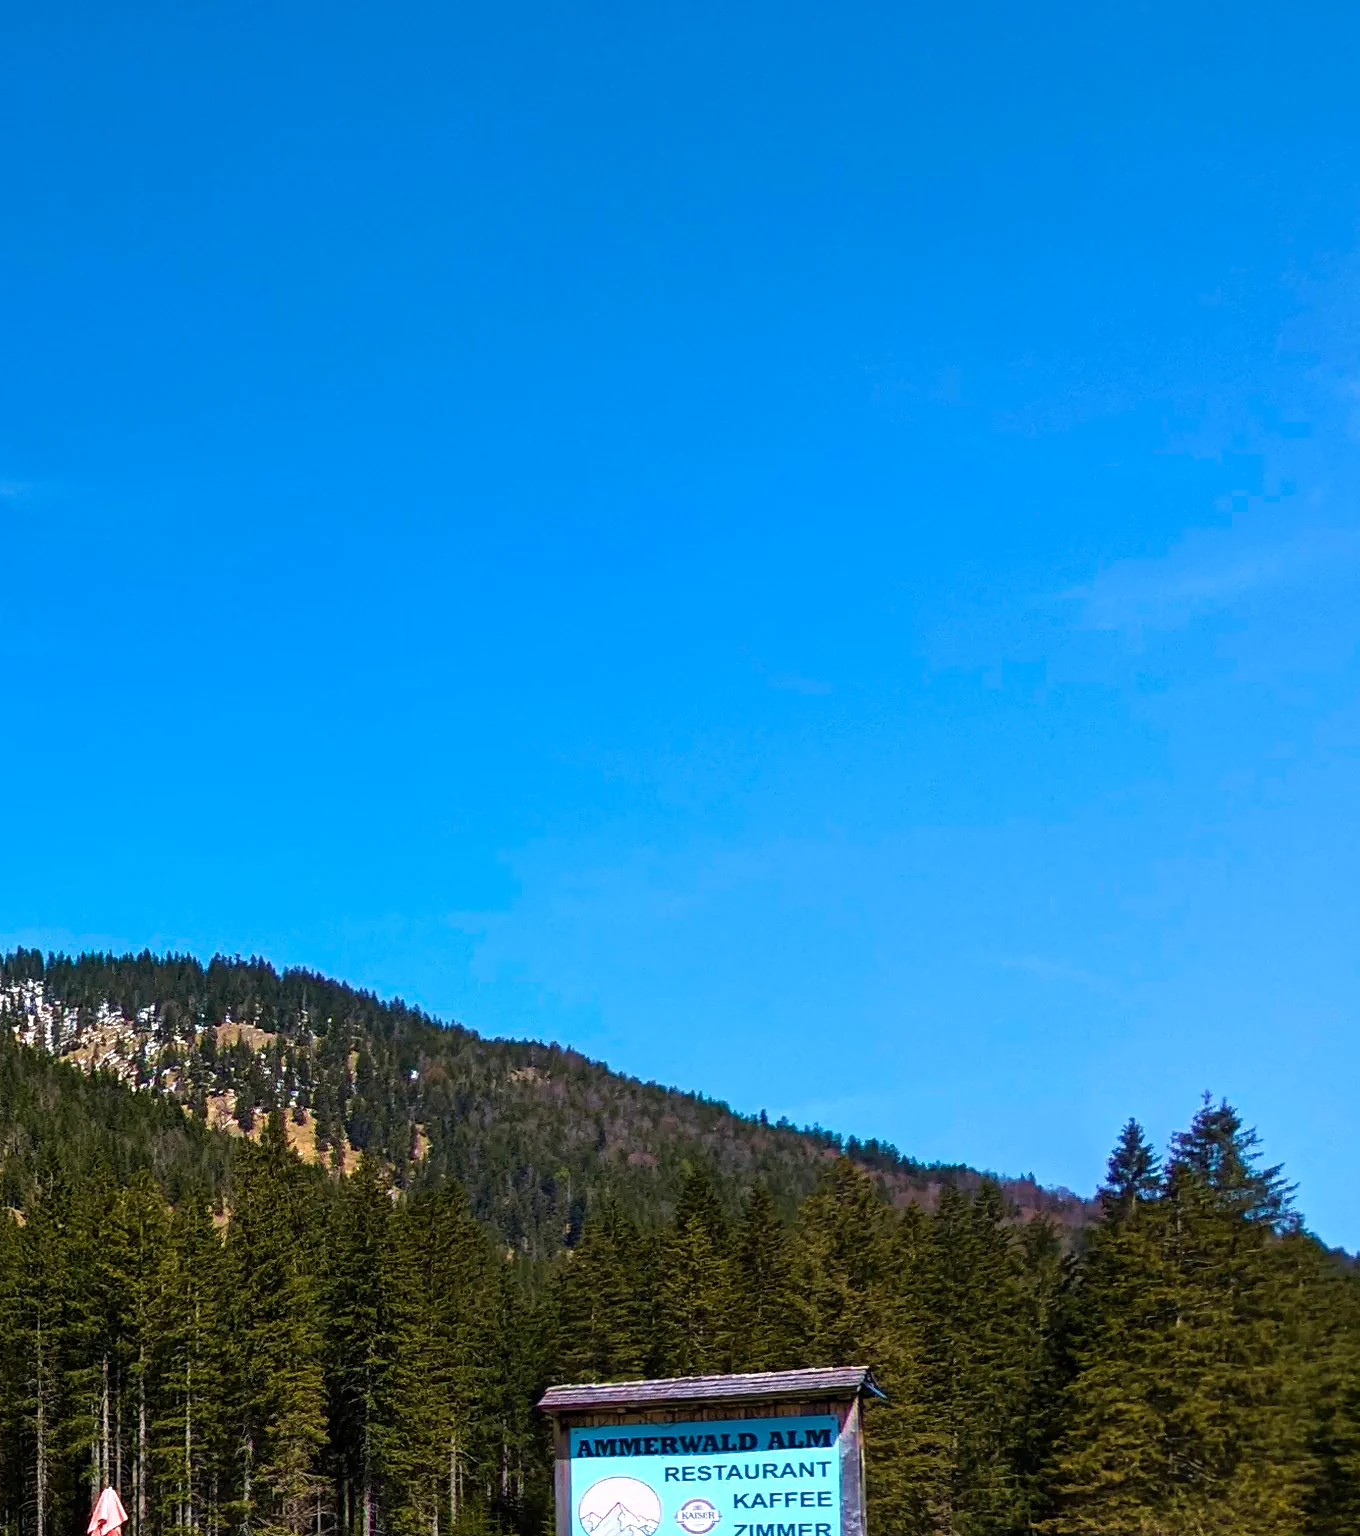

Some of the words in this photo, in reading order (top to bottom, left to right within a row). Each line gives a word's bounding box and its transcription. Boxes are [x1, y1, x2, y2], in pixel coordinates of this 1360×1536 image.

[577, 1432, 759, 1457] AMMERWALD
[768, 1429, 832, 1451] ALM
[664, 1461, 832, 1482] RESTAURANT
[733, 1491, 833, 1509] KAFFEE
[681, 1511, 715, 1520] KAISER
